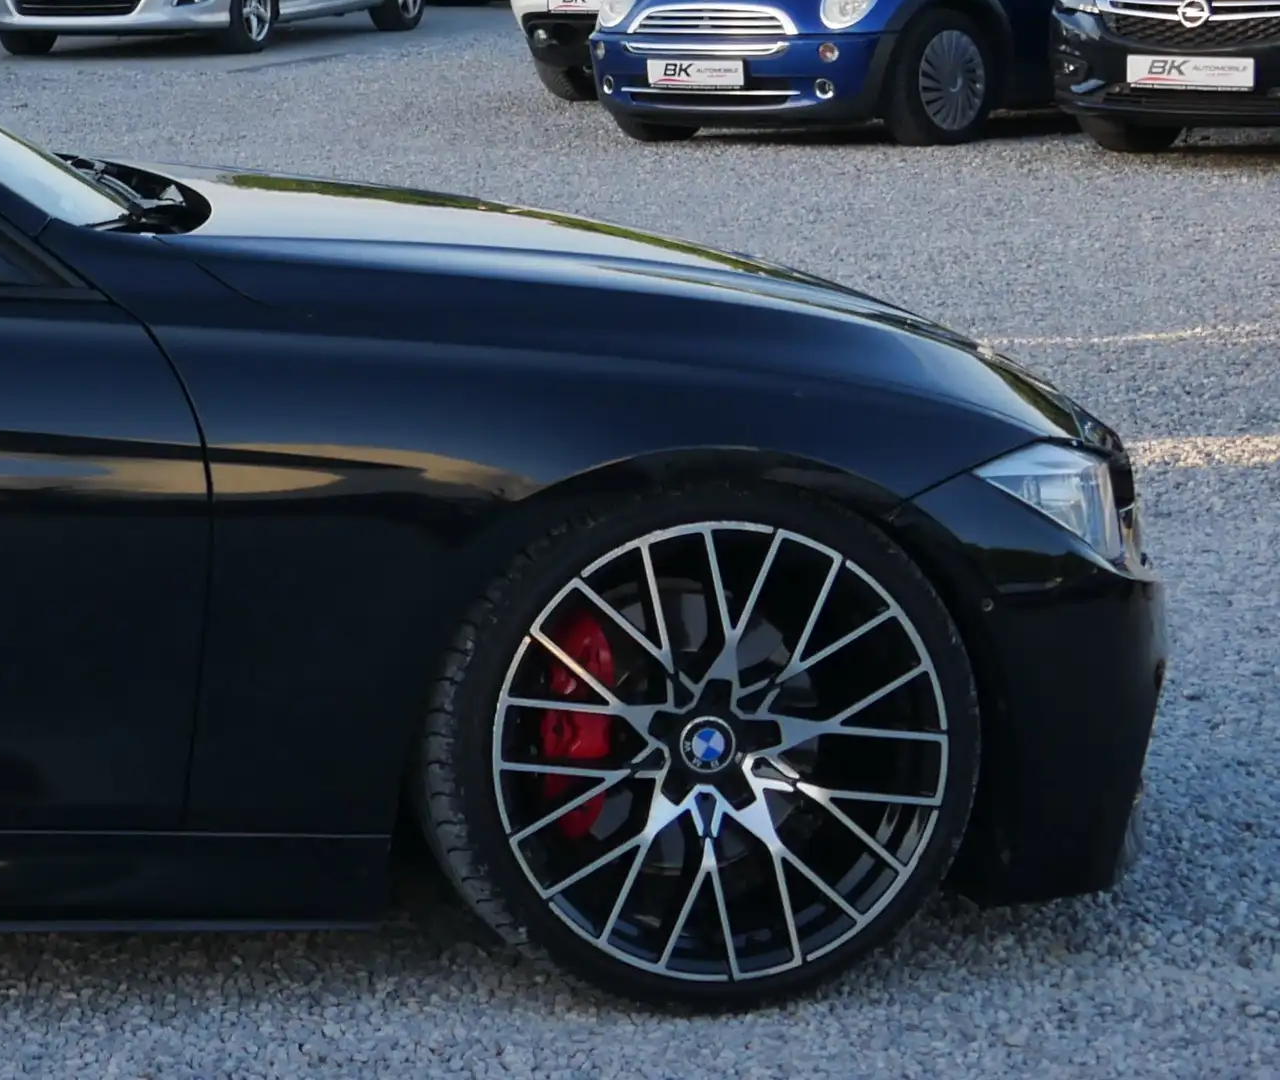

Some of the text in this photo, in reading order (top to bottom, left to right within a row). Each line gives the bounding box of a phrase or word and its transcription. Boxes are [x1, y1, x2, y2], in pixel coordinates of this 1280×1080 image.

[663, 62, 695, 77] BK
[1147, 59, 1249, 76] BK AUTOMOBILE
